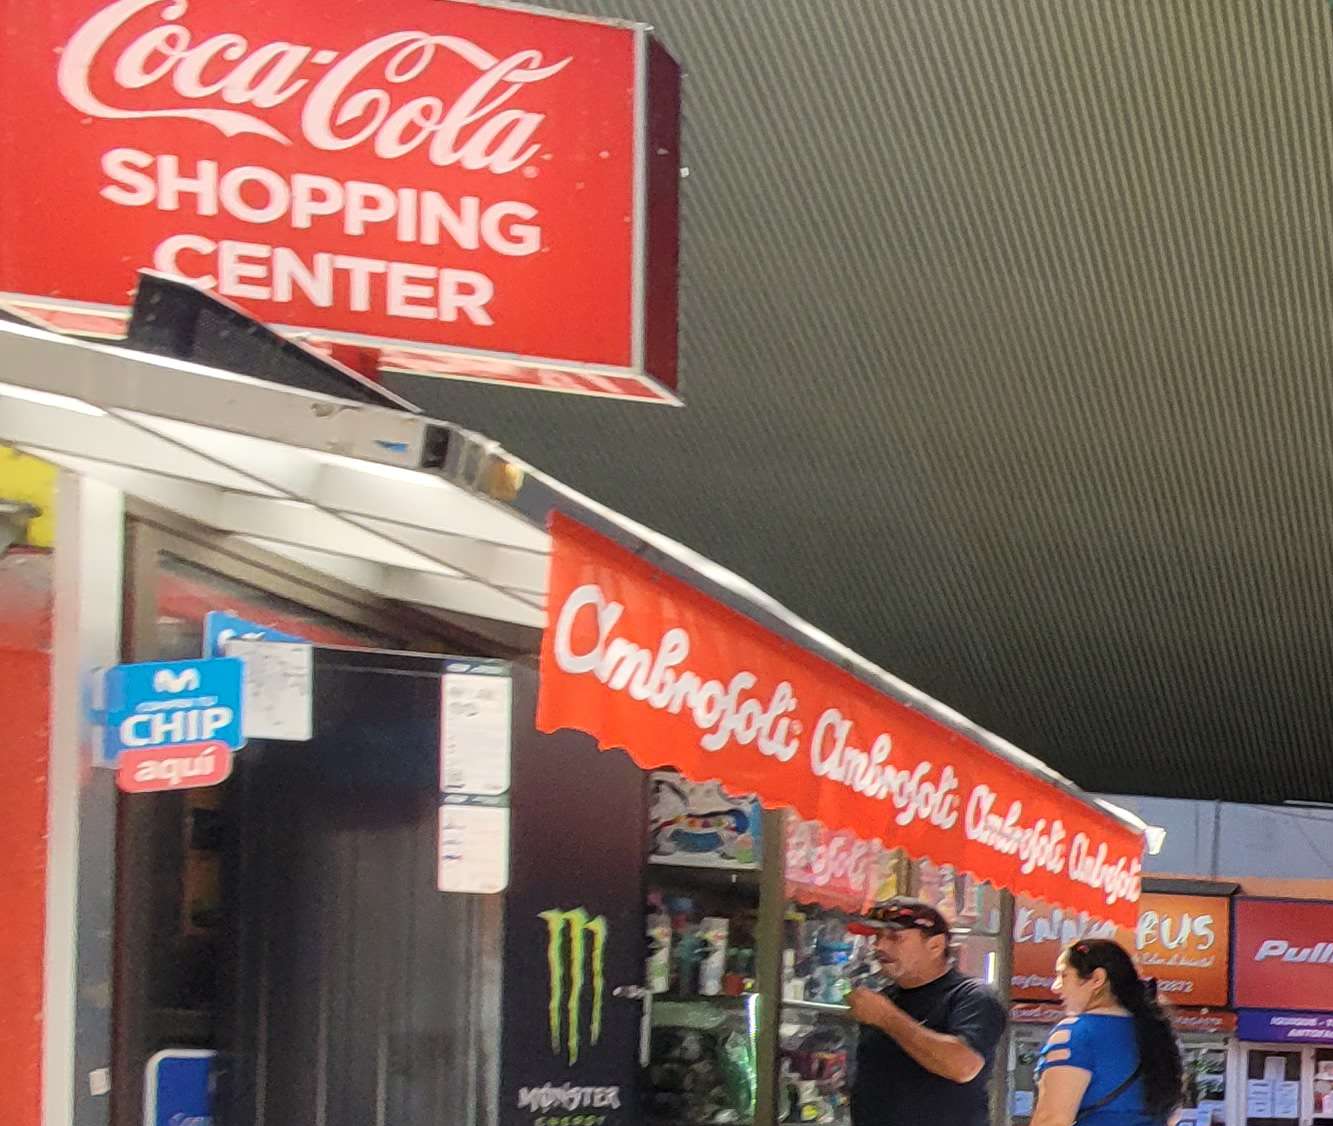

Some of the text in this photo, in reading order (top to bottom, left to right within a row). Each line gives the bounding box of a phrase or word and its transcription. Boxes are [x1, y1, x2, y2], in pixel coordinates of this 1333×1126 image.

[57, 0, 572, 174] Coca-Cola
[100, 148, 541, 256] SHOPPING
[153, 234, 495, 327] CENTER
[555, 585, 799, 762] Ambrosoli
[120, 707, 233, 746] CHIP
[134, 746, 217, 785] aquí
[811, 708, 958, 829] Ambrosoli
[965, 785, 1065, 874] Ambrosoli
[1136, 910, 1216, 950] BUS
[517, 1081, 621, 1113] MONSTER
